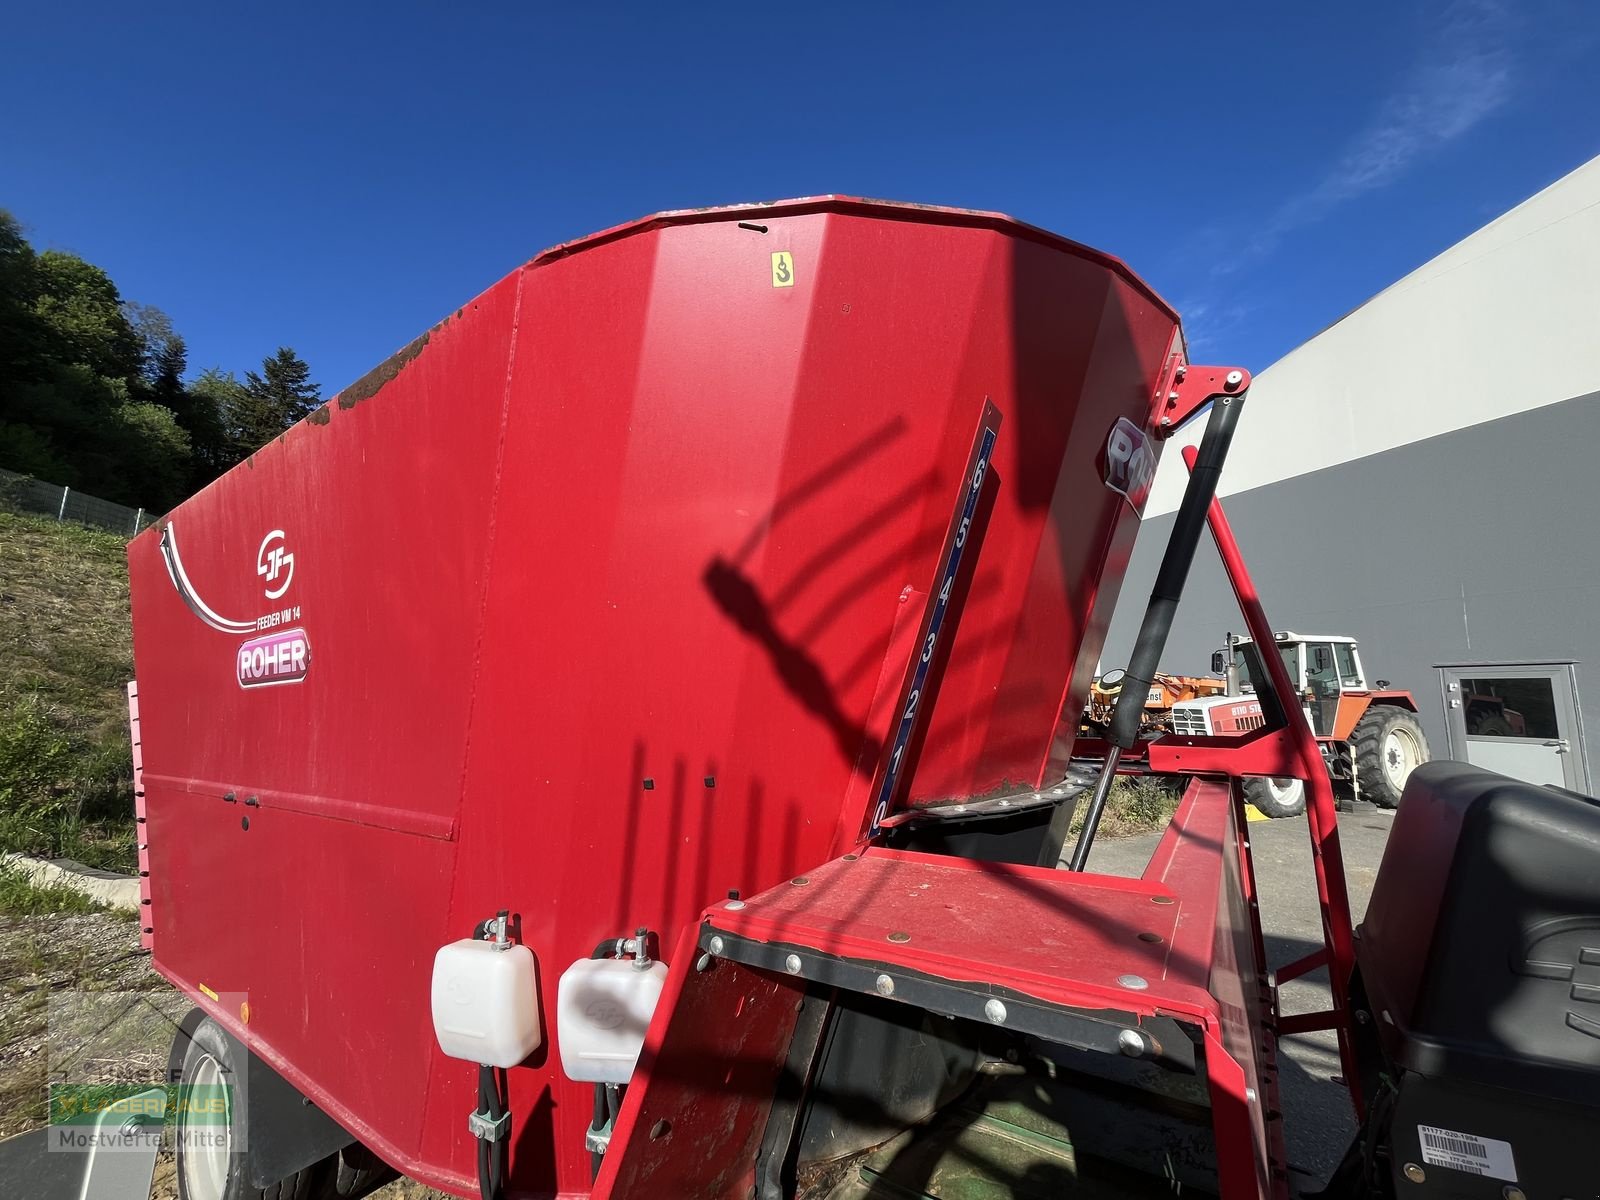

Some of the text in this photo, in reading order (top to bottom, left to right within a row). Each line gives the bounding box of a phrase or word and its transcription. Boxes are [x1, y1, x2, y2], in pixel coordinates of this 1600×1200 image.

[972, 458, 985, 492] 6
[955, 516, 970, 549] 5
[939, 576, 953, 606] 4
[256, 605, 301, 631] FEEDER VM 14
[240, 639, 307, 680] ROHER
[921, 632, 936, 663] 3
[903, 689, 920, 720] 2
[891, 745, 903, 775] 1
[873, 801, 887, 830] 0
